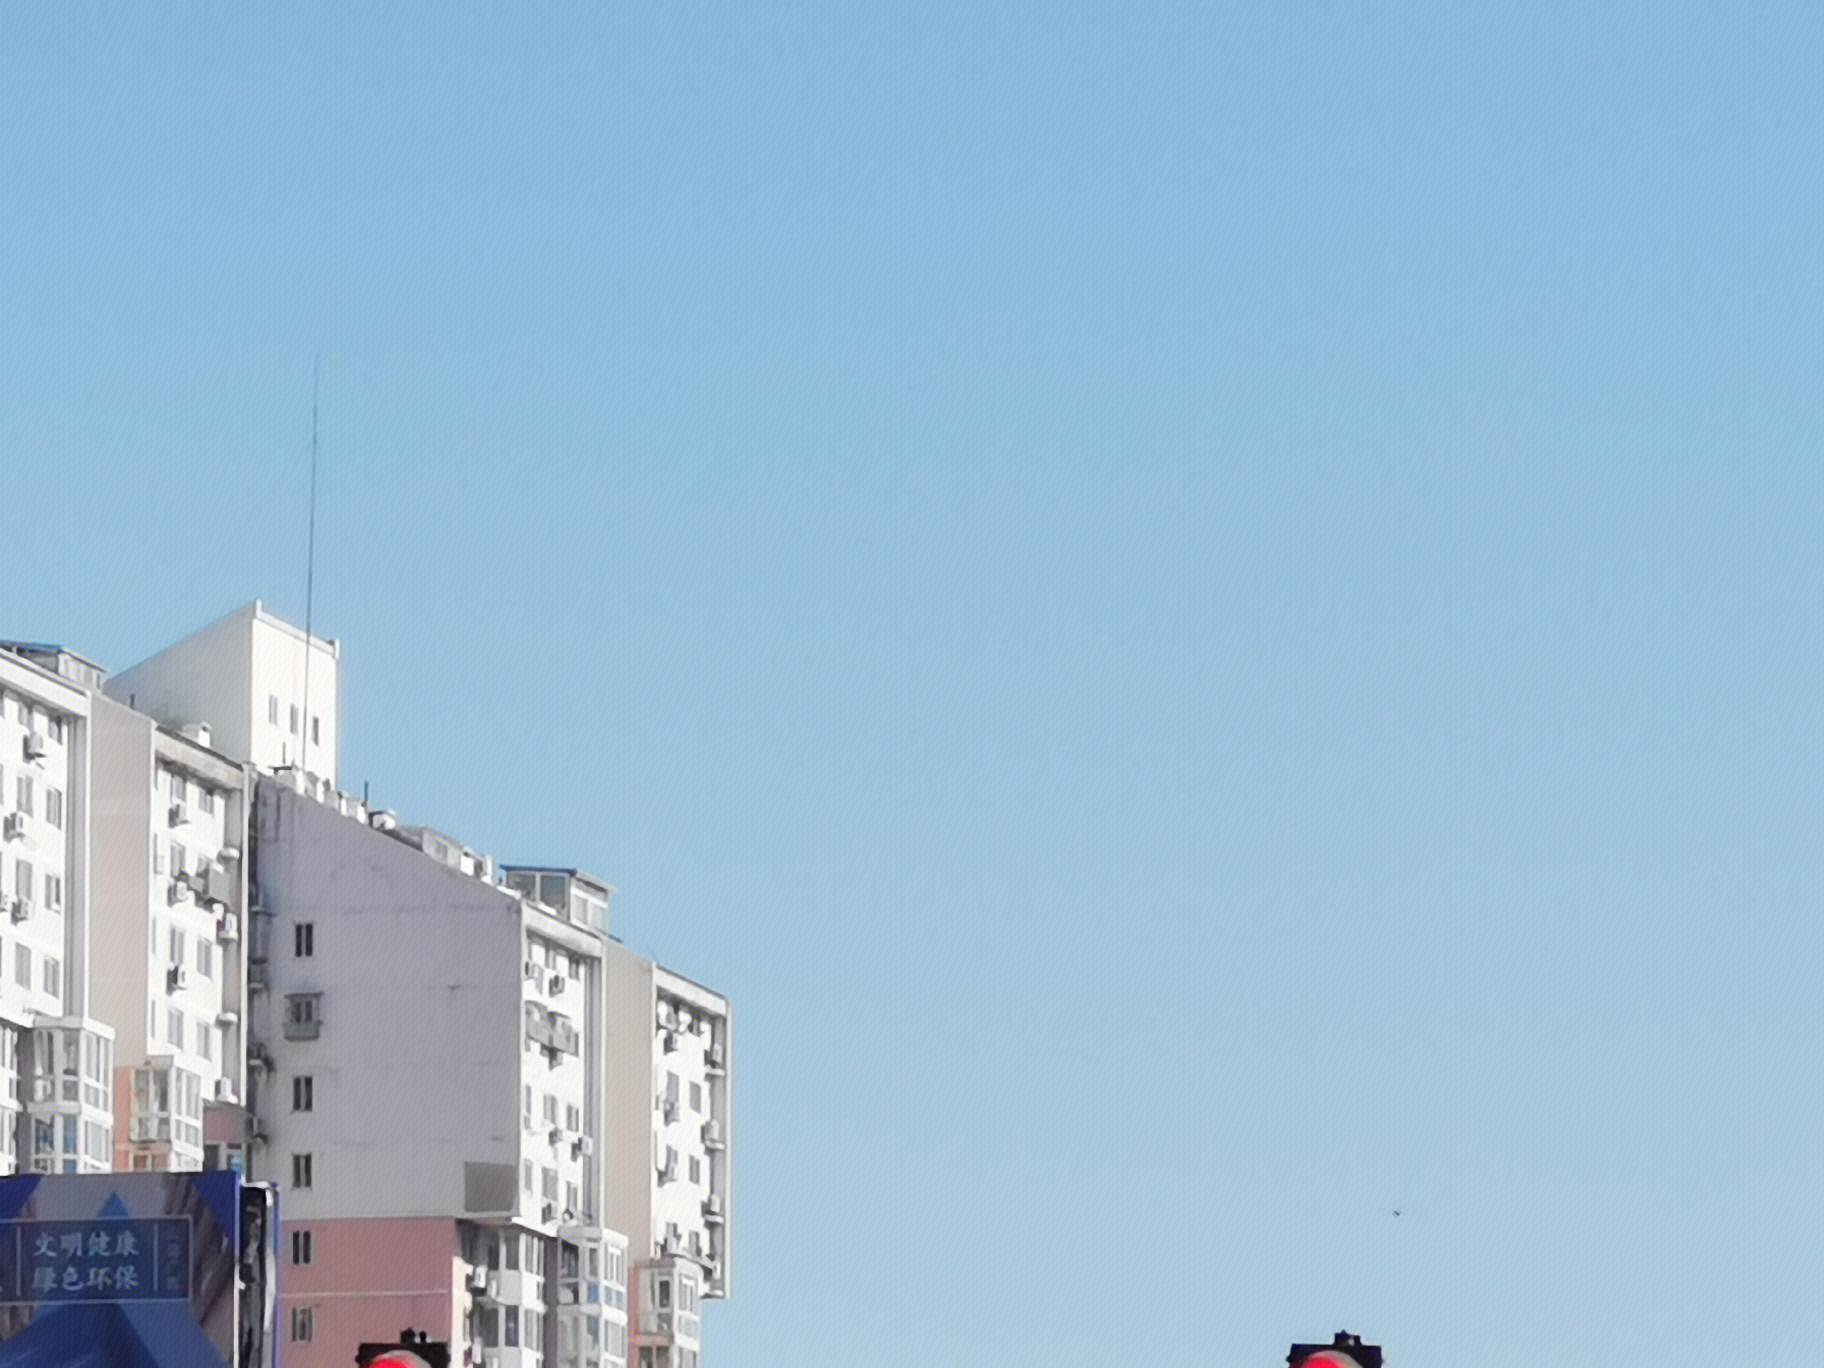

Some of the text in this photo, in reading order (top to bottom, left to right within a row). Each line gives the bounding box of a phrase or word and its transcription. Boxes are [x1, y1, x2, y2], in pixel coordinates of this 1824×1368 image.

[34, 1230, 139, 1257] 文明健康
[32, 1265, 139, 1292] 绿色环保
